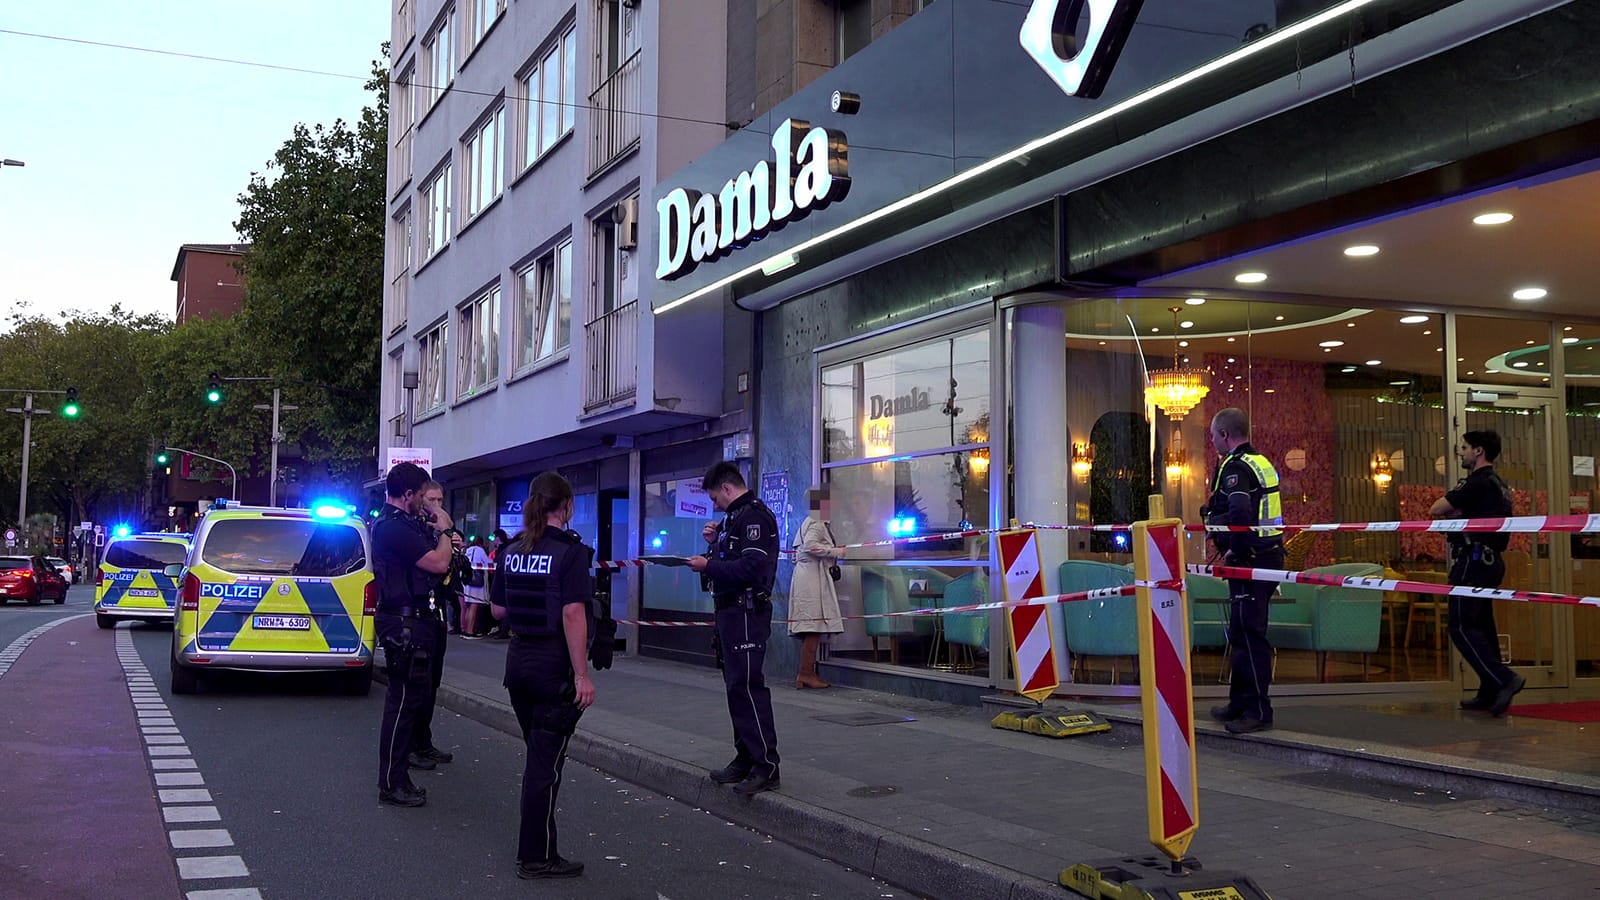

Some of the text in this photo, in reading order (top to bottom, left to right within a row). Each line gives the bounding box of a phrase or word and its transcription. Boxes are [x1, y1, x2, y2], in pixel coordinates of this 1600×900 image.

[656, 118, 833, 280] Damla
[870, 387, 929, 420] Damla
[765, 488, 785, 501] NACHT
[506, 501, 522, 512] 73
[504, 553, 553, 574] POLIZEI
[103, 573, 134, 581] POLIZEI
[201, 583, 263, 598] POLIZEI
